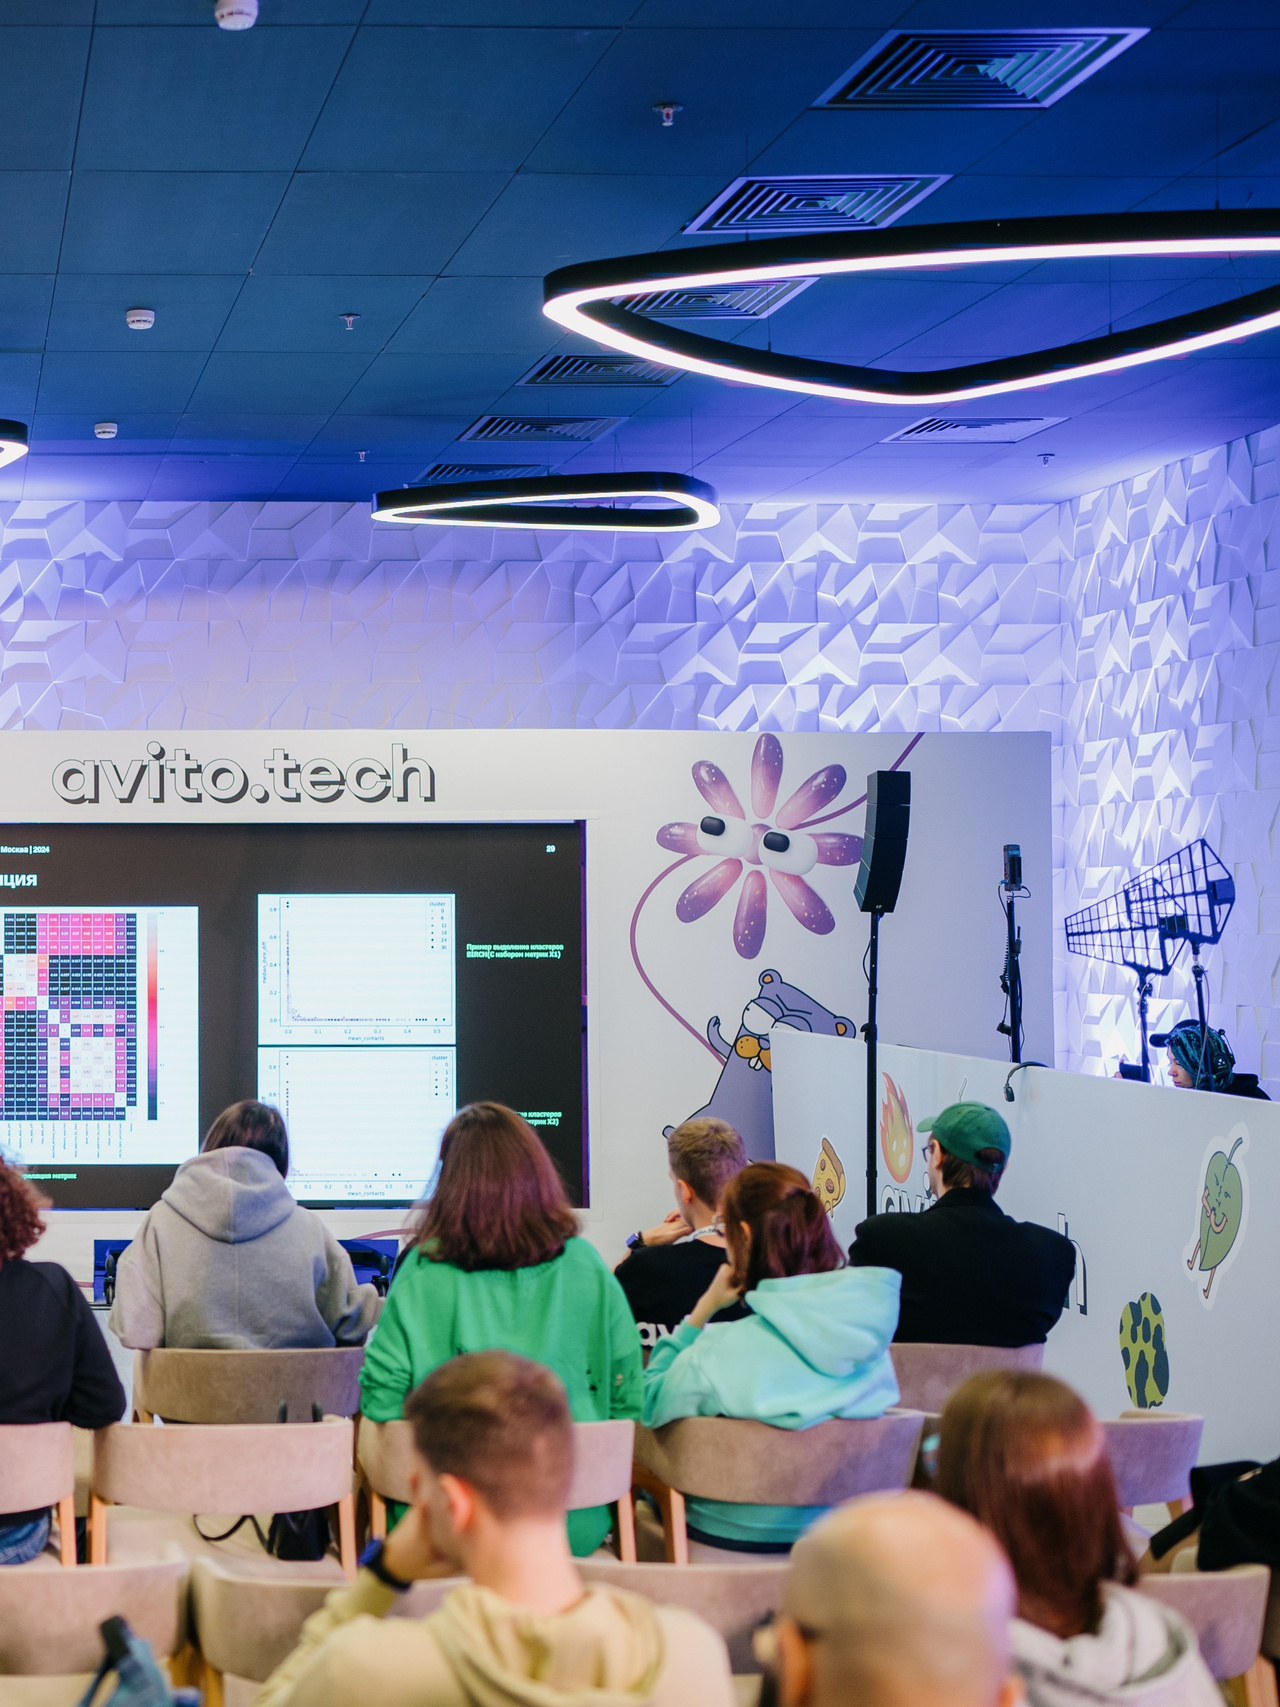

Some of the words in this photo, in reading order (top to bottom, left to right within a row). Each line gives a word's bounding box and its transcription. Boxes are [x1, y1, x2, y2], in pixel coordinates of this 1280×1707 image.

[51, 741, 436, 804] avito.tech
[0, 846, 28, 854] Москва
[33, 846, 50, 854] 2024
[546, 845, 556, 853] 29
[466, 943, 492, 951] Пример
[496, 951, 524, 959] набором
